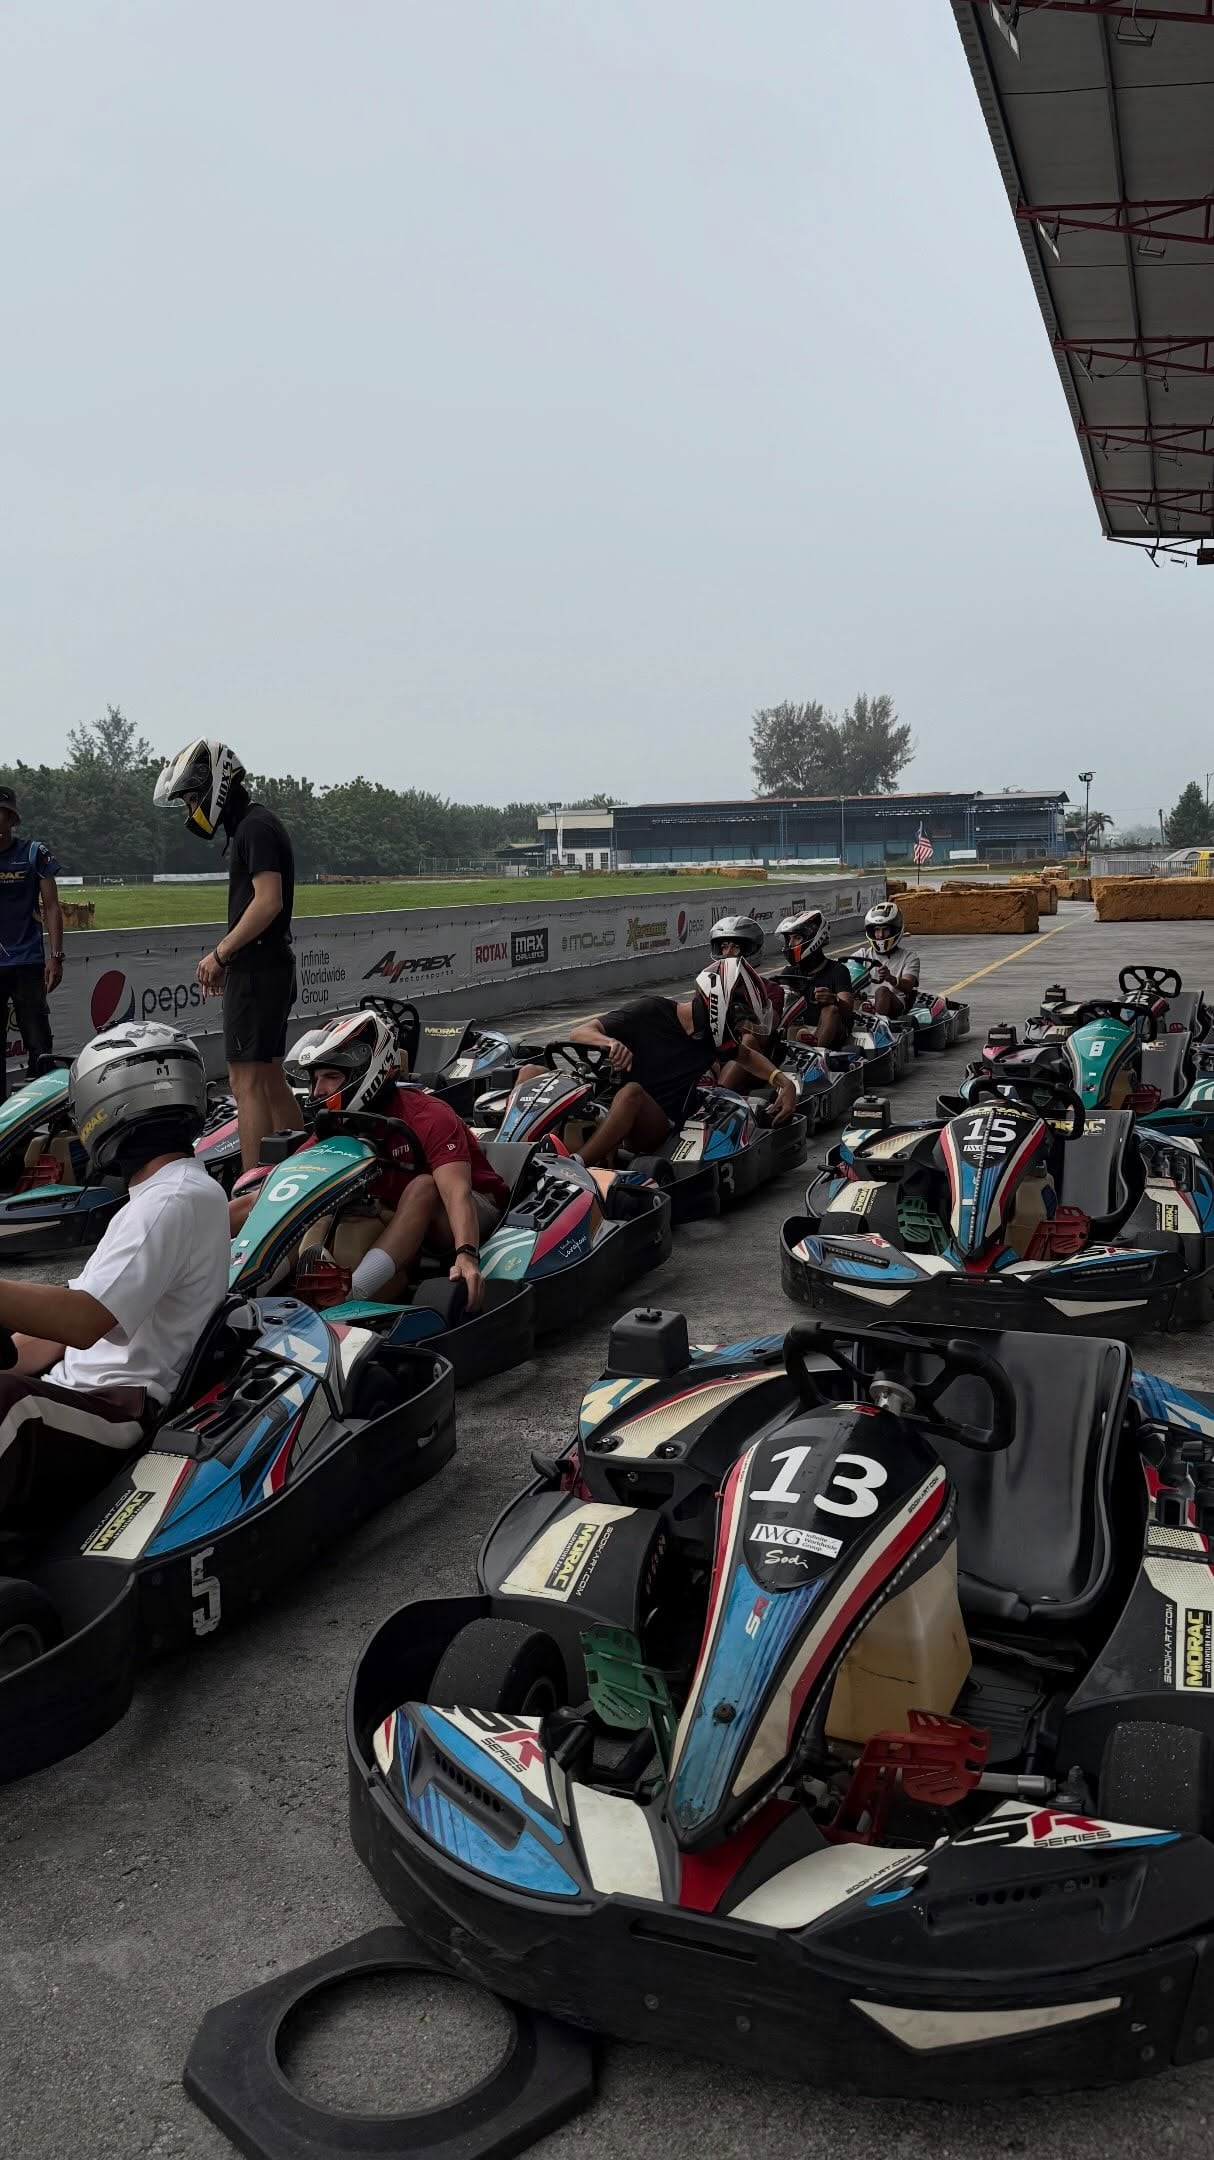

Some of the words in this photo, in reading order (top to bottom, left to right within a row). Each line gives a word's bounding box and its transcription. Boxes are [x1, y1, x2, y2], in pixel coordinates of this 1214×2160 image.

[301, 950, 330, 967] Infinite
[475, 942, 508, 964] ROTAX
[301, 967, 346, 985] Worldwide
[301, 988, 329, 1005] Group
[424, 1026, 463, 1035] MORAC
[963, 1118, 1017, 1142] 15
[268, 1174, 309, 1202] 6
[749, 1445, 888, 1518] 13
[91, 1491, 150, 1551] MORAC
[755, 1525, 803, 1545] IWG
[553, 1524, 598, 1589] MORAC
[576, 1526, 614, 1596] SODIKART.COM
[764, 1549, 809, 1569] Sodi
[190, 1546, 222, 1637] 5
[1163, 1603, 1174, 1685] SODIKART.COM
[1185, 1610, 1204, 1687] MORAC
[481, 1736, 528, 1773] SERIES
[1033, 1829, 1112, 1848] SERIES
